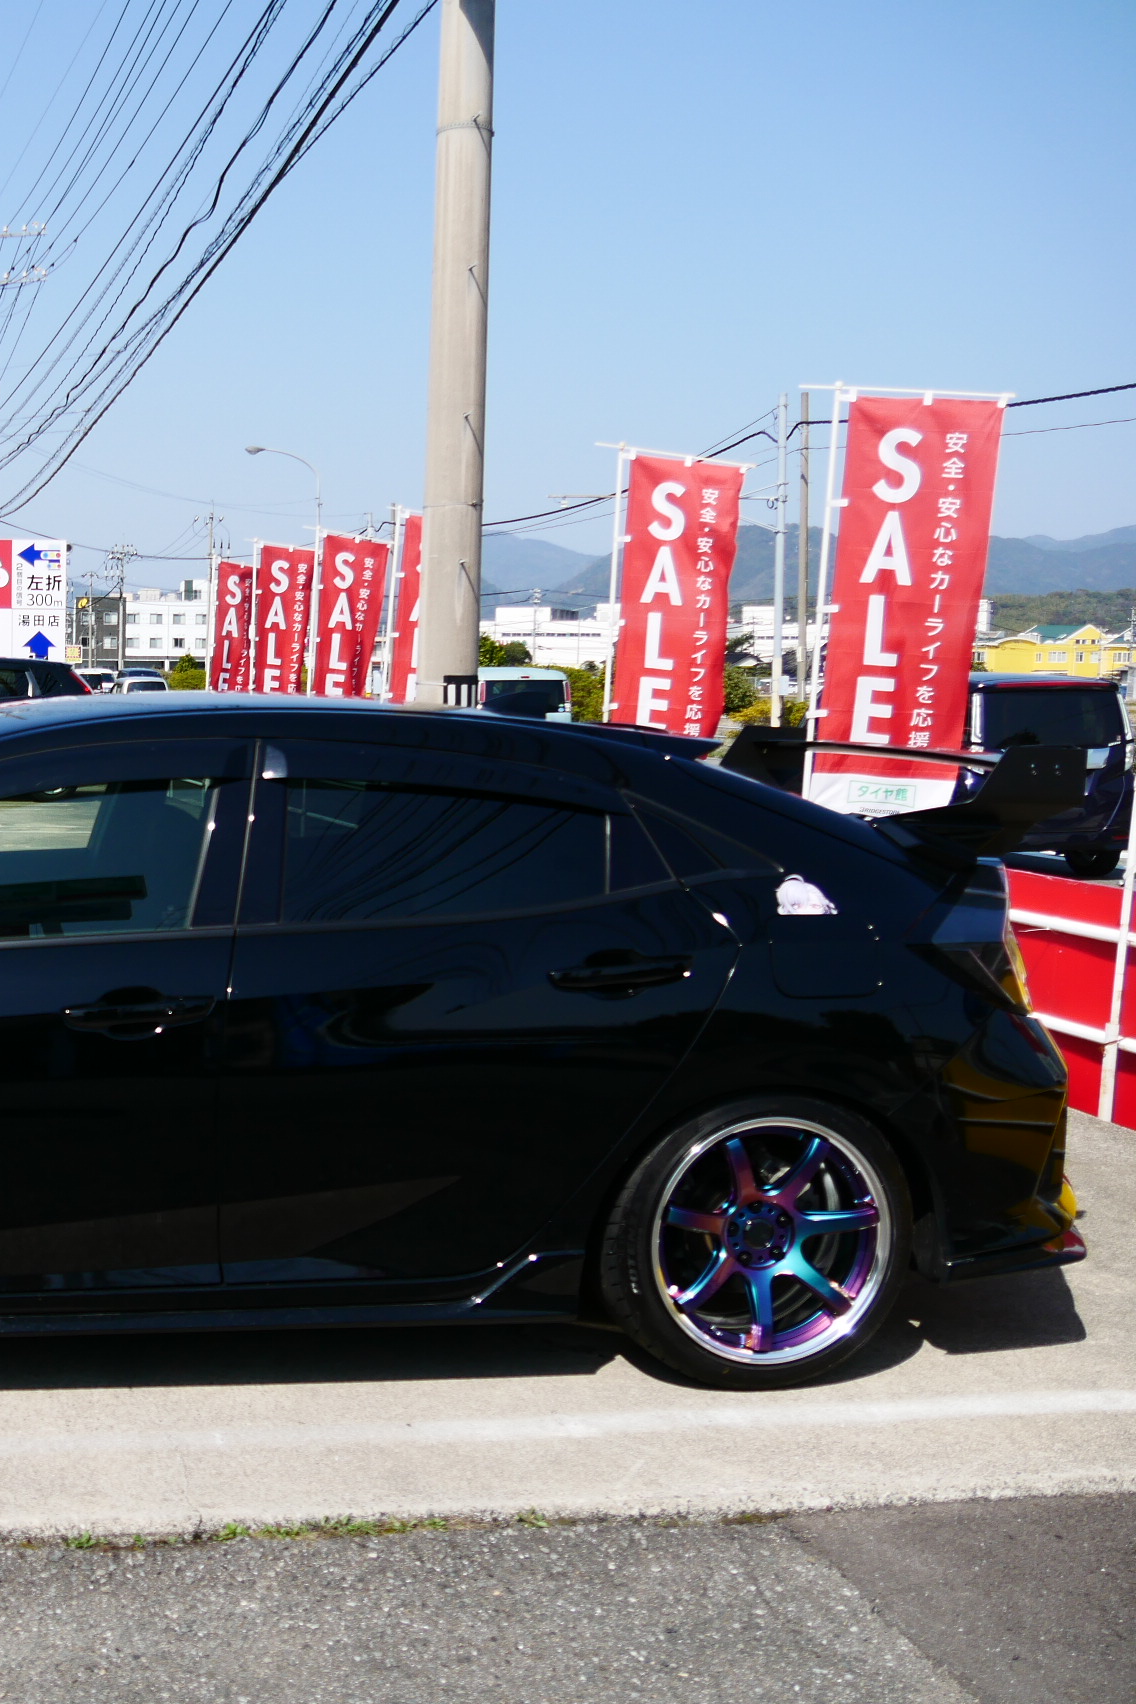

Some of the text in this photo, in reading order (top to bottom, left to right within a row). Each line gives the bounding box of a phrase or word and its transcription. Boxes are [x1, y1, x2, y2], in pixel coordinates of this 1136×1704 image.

[18, 615, 60, 627] 湯田店
[27, 575, 62, 591] 左折
[27, 593, 63, 607] 300m
[263, 560, 290, 693] SALE
[325, 552, 356, 695] SALE
[635, 481, 687, 730] SALE
[849, 427, 924, 744] SALE
[907, 432, 969, 748] 安全・安心なカーライフを応援
[858, 785, 909, 801] タイヤ館
